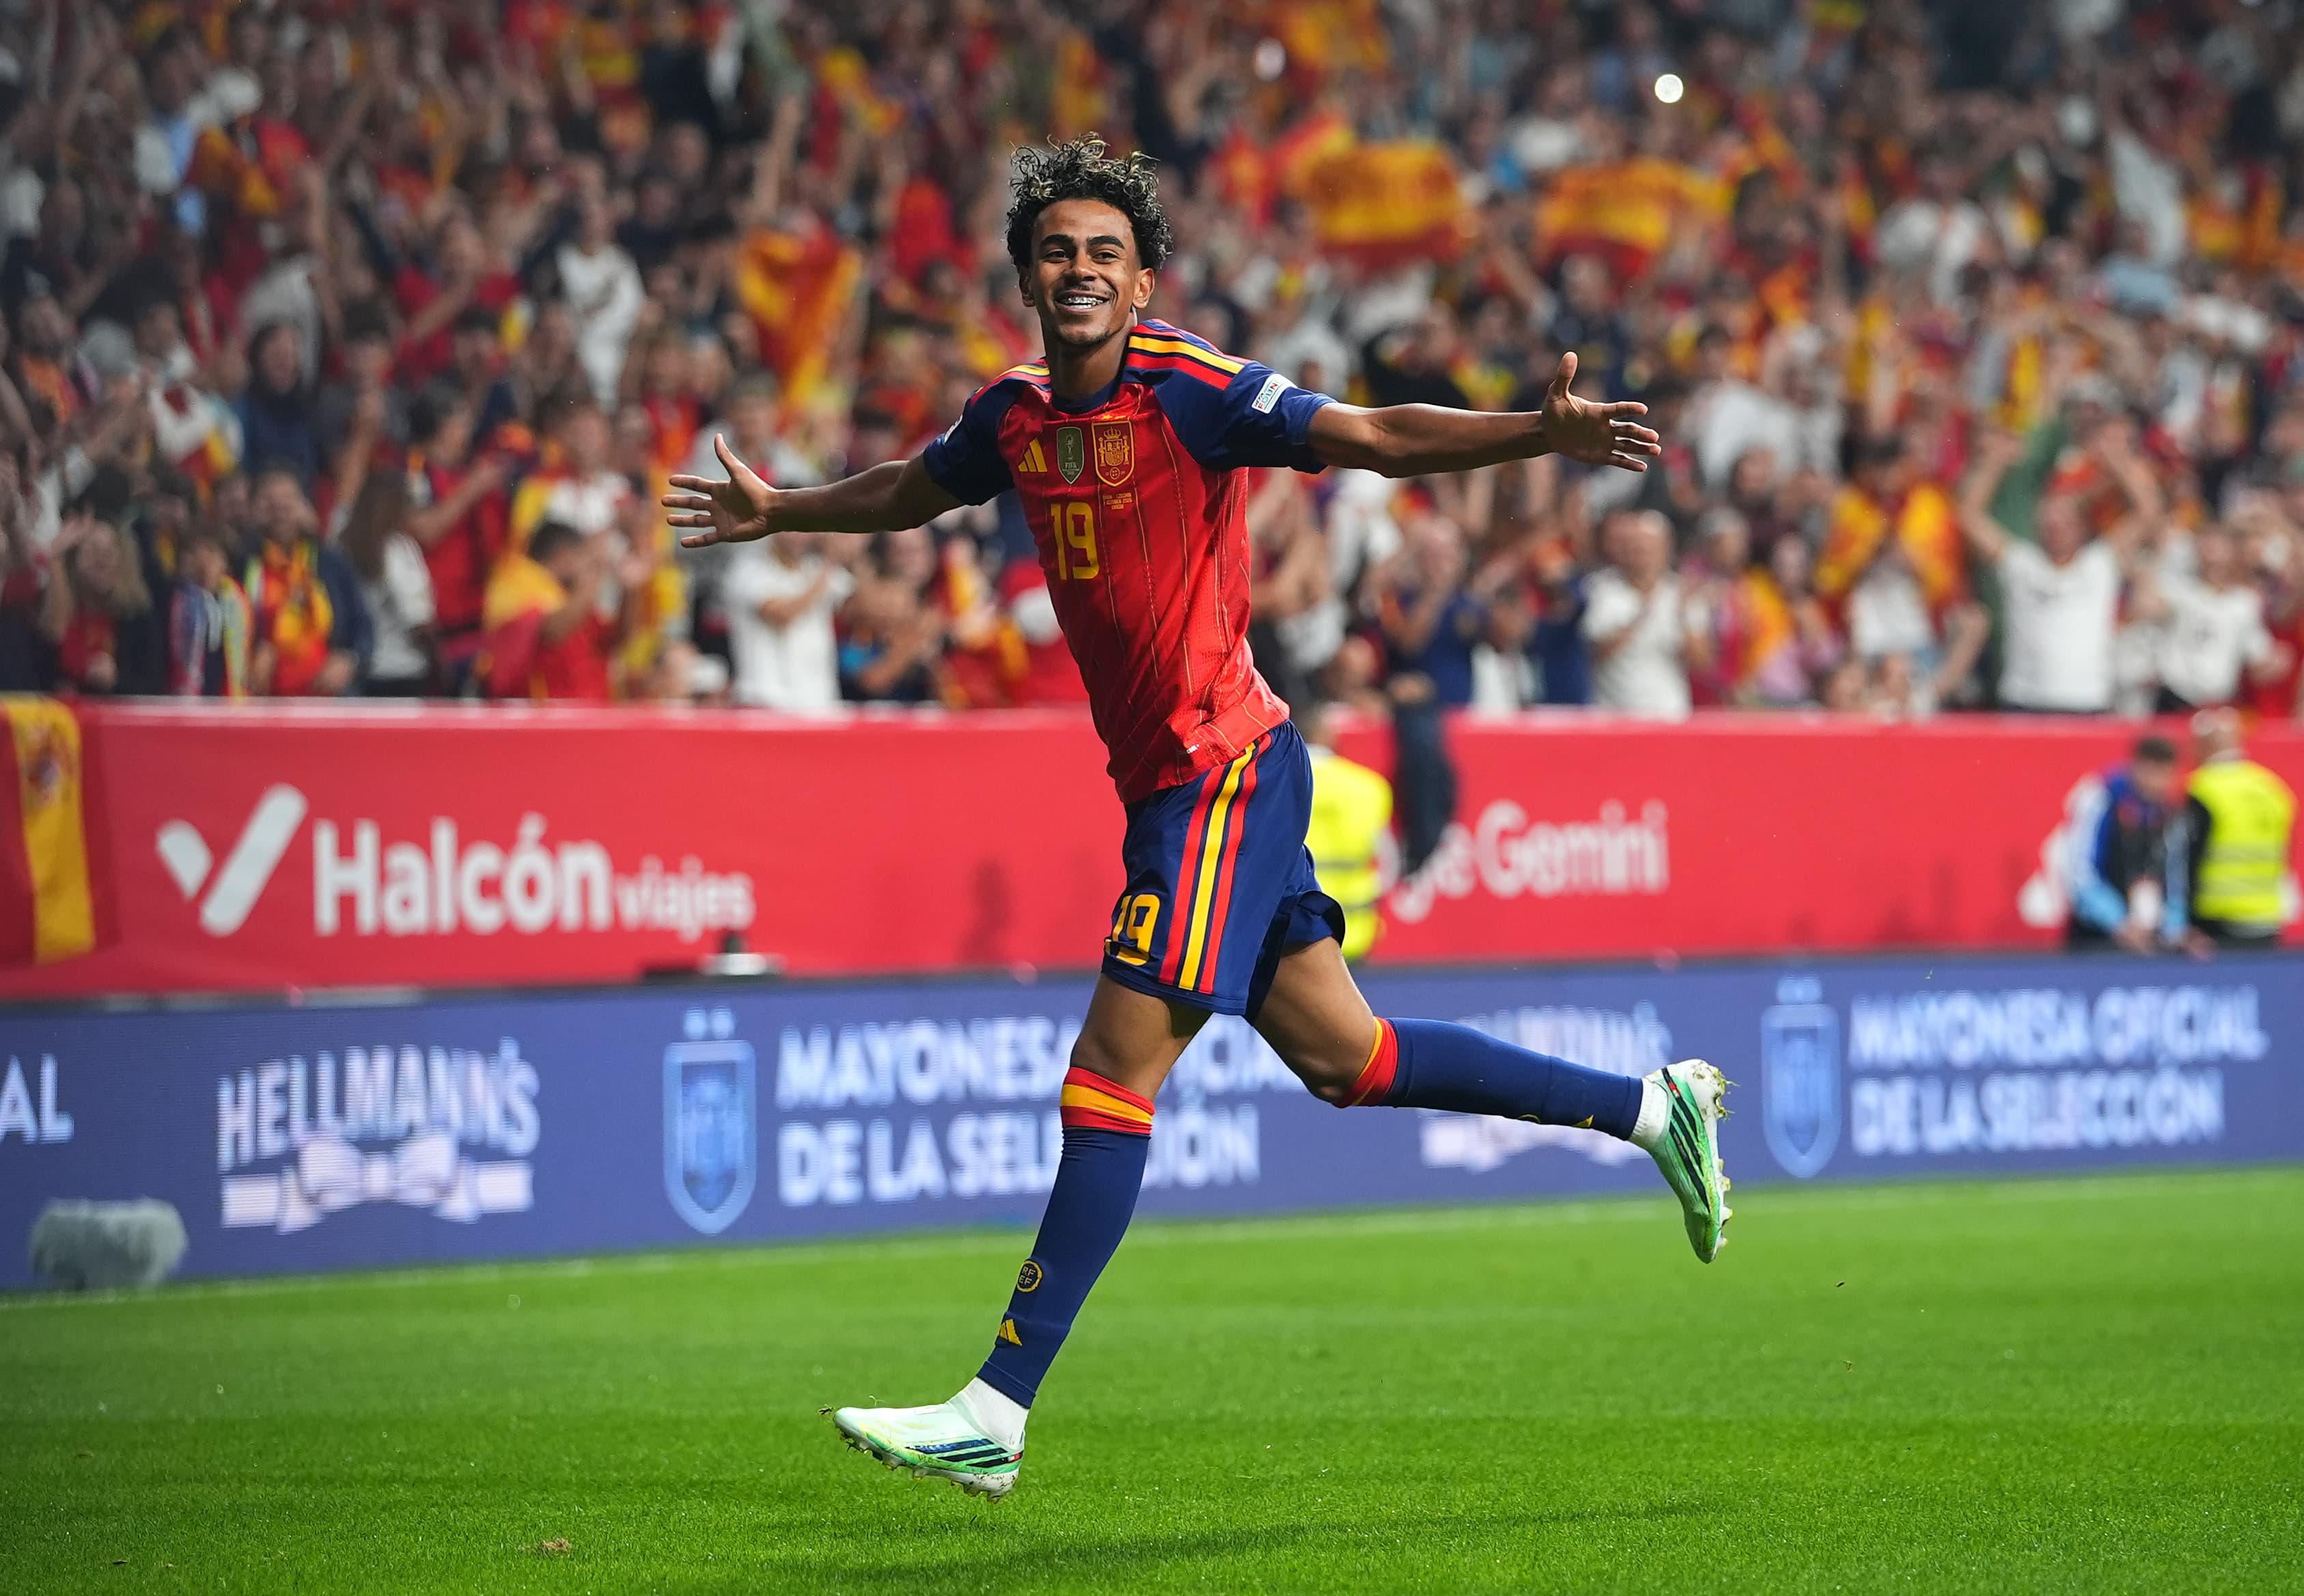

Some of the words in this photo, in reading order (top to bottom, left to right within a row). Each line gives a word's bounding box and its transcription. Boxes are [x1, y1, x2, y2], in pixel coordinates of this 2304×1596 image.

[1051, 502, 1100, 580] 19
[311, 811, 613, 936] Halcón
[614, 854, 756, 942] viajes
[1475, 799, 1668, 899] Gemini
[1105, 893, 1160, 966] 19
[1851, 990, 2092, 1068] MAYONESA
[2093, 985, 2269, 1063] OFICIAL
[0, 1052, 74, 1143] AL
[1850, 1076, 1917, 1156] DE
[1920, 1072, 1982, 1152] LA
[1980, 1054, 2225, 1150] SELECCIÓN
[777, 1119, 863, 1207] DE
[865, 1115, 950, 1203] LA
[1019, 1276, 1032, 1285] EF
[1023, 1267, 1036, 1276] RF
